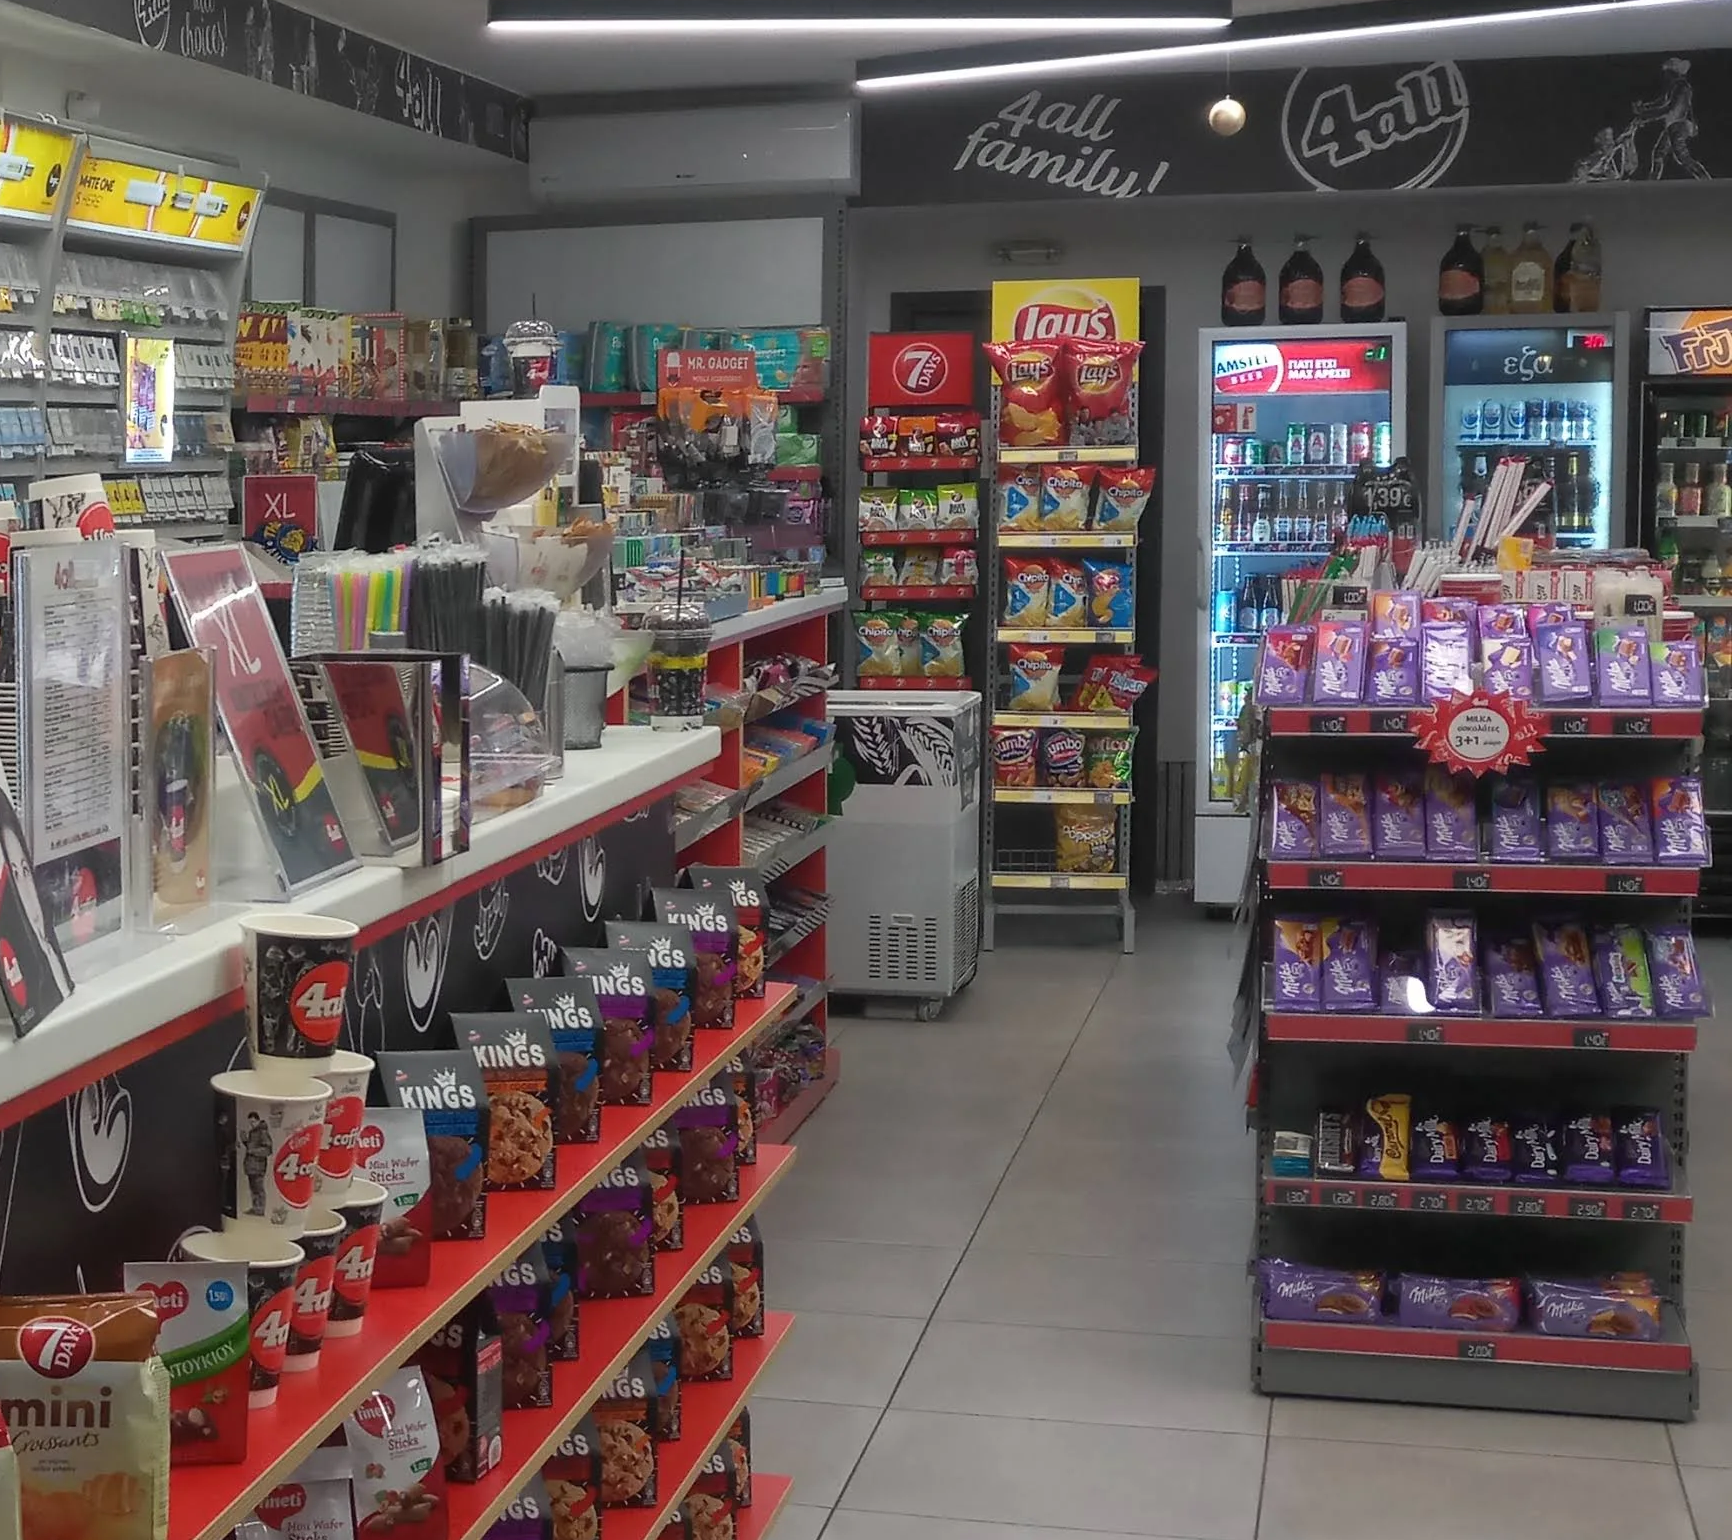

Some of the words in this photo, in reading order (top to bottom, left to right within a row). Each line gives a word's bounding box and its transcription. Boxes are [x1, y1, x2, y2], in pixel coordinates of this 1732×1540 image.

[998, 87, 1122, 142] 4all
[954, 120, 1170, 199] family!
[687, 356, 706, 370] MR.
[707, 356, 749, 370] GADGET
[901, 349, 929, 389] 7
[918, 352, 942, 388] DAYS
[1503, 345, 1554, 382] εζα
[1230, 370, 1264, 385] BEER
[1047, 476, 1083, 491] Chipita
[1108, 486, 1144, 499] Chipita
[264, 493, 297, 521] XL
[1017, 659, 1053, 671] Chipita
[1465, 715, 1493, 723] MILKA
[1455, 735, 1480, 748] 3+1
[472, 1044, 546, 1068] KINGS
[398, 1086, 477, 1111] KINGS
[369, 1158, 391, 1170] Mini
[392, 1157, 420, 1170] Wafer
[369, 1168, 406, 1183] Sticks
[1277, 1280, 1317, 1299] Milka
[1408, 1286, 1447, 1305] Milka
[1546, 1300, 1586, 1319] Milka
[28, 1323, 68, 1379] 7
[53, 1322, 84, 1369] DAYS
[1, 1385, 112, 1431] mini
[388, 1437, 419, 1450] Sticks
[286, 1519, 309, 1532] Mini
[311, 1517, 345, 1532] Wafer
